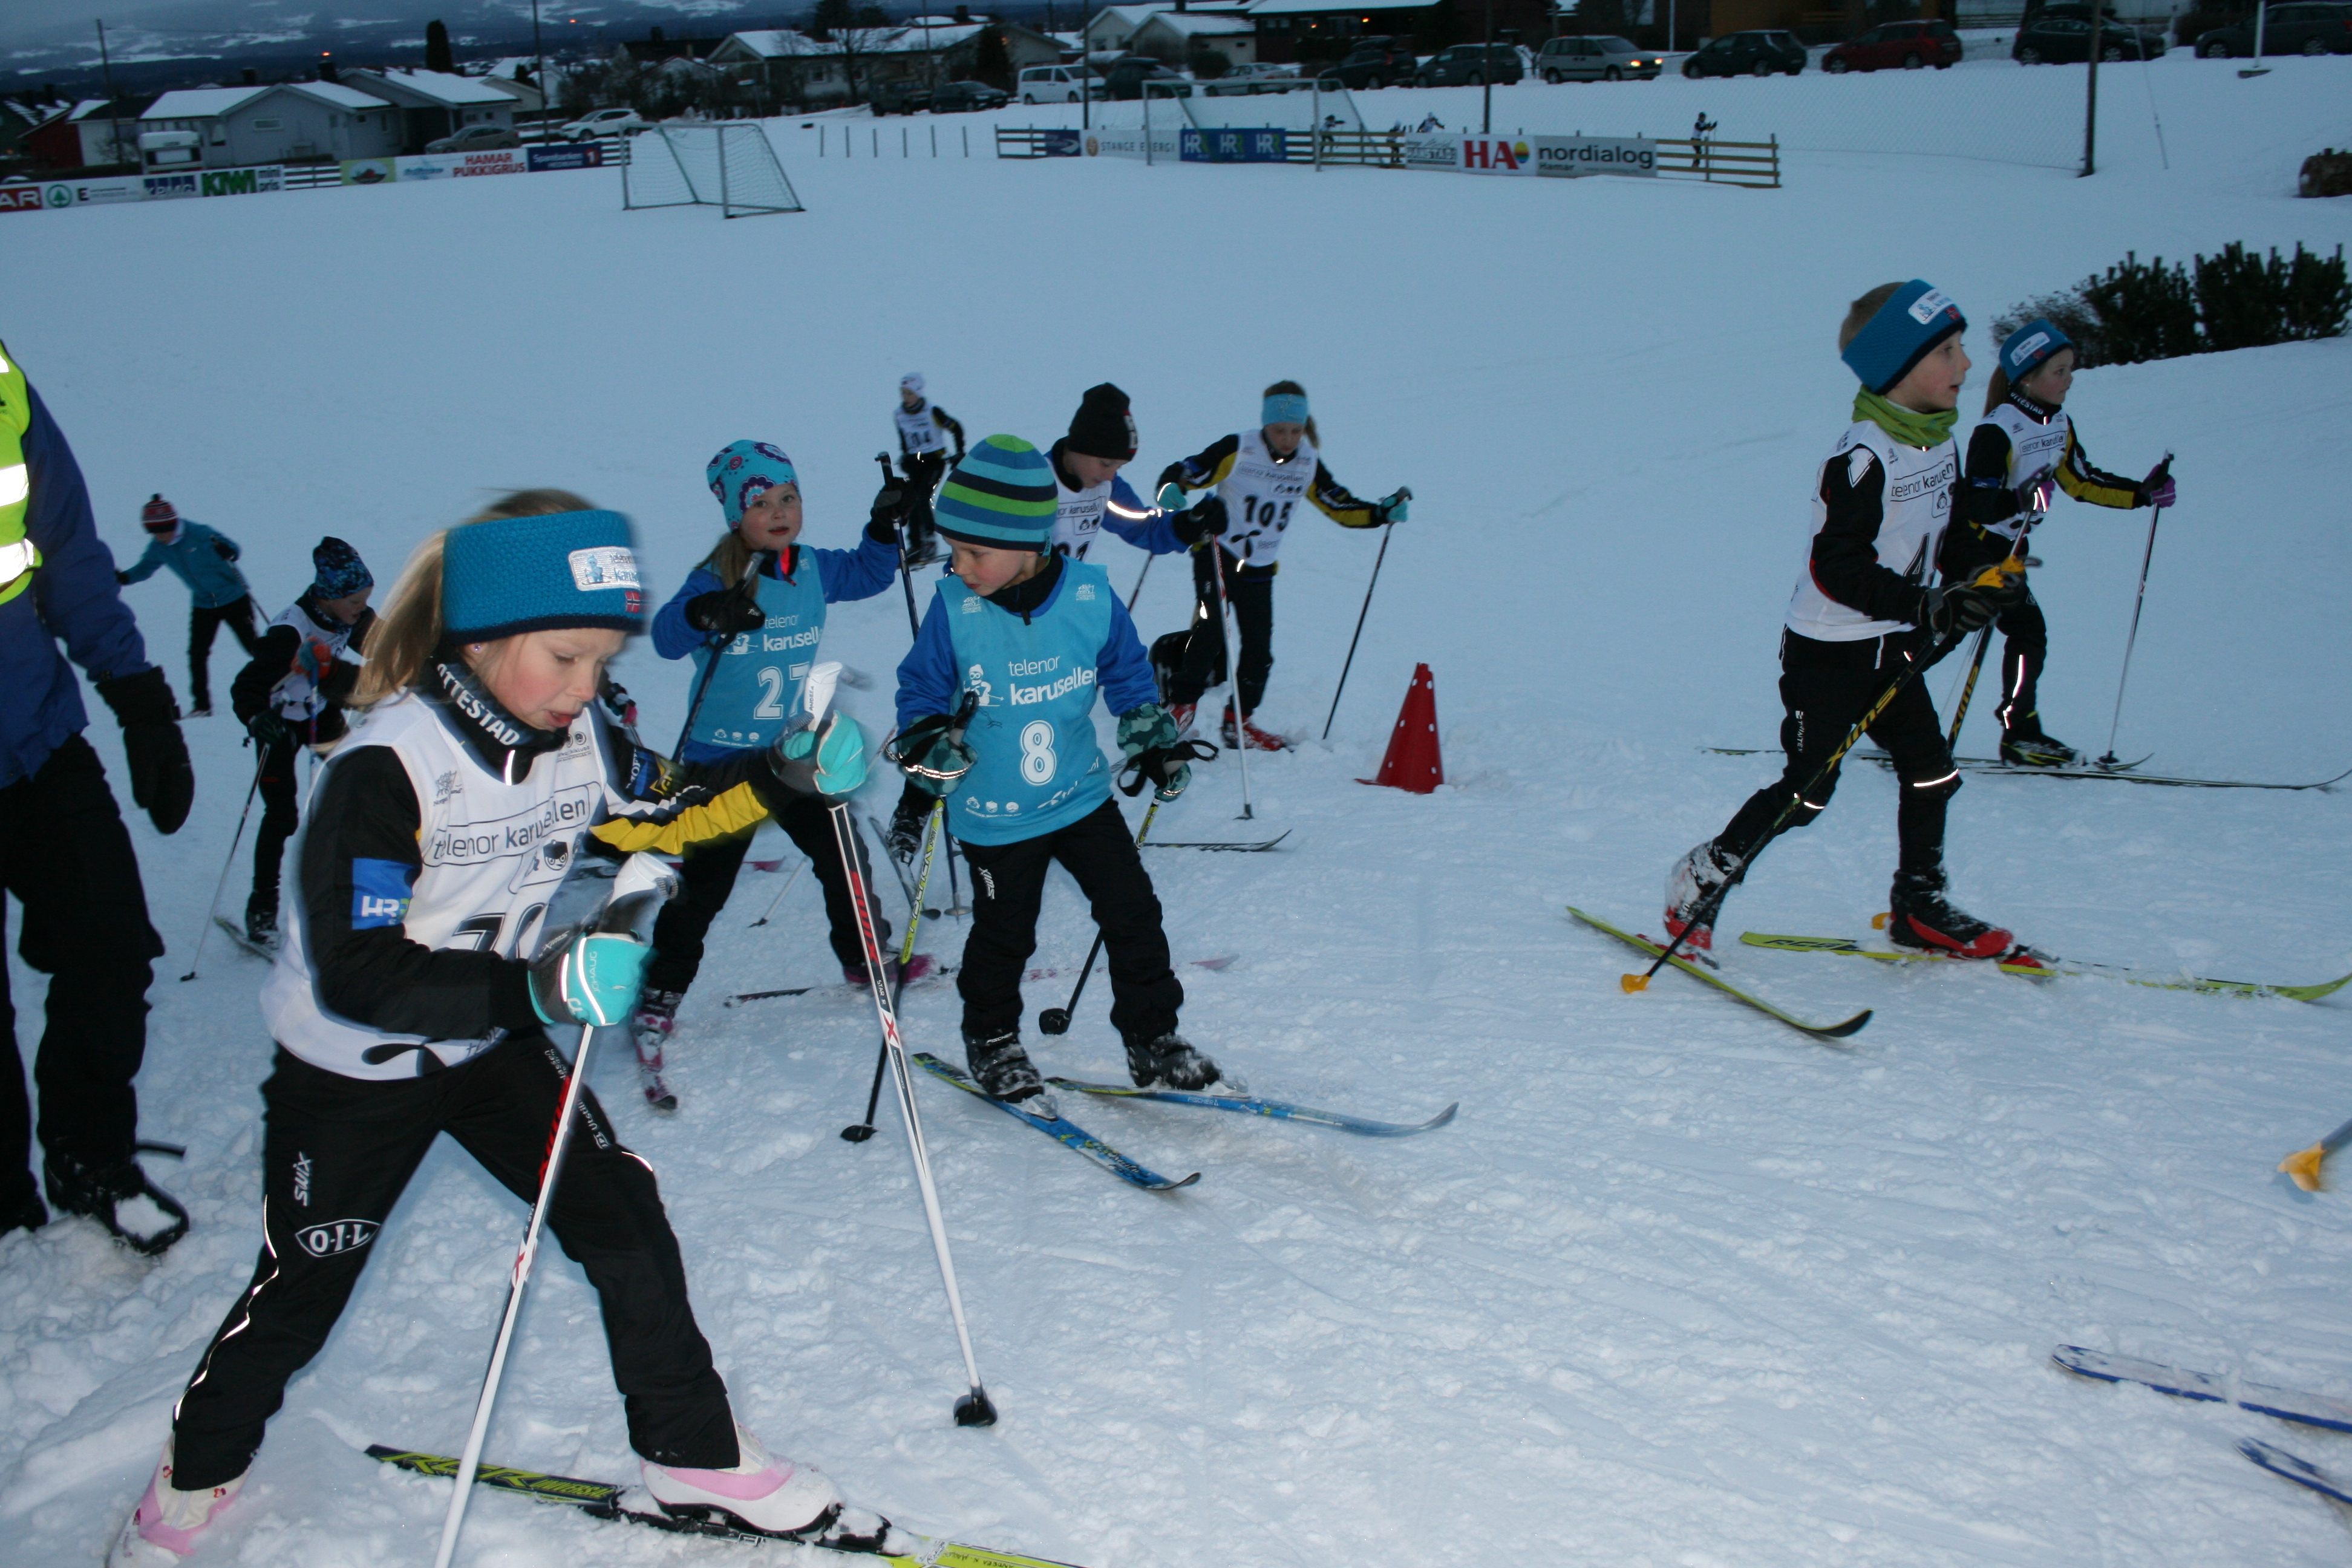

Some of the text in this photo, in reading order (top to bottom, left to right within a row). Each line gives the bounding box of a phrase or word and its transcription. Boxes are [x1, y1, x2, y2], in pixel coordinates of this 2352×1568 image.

[465, 152, 513, 165] HAMAR
[1100, 141, 1175, 153] STANGE EERGI
[1463, 140, 1520, 169] HA
[1538, 145, 1653, 169] nordialog
[201, 169, 257, 197] KIWI
[1244, 494, 1294, 532] 105
[1008, 655, 1060, 676] telenor
[754, 661, 810, 720] 27
[1020, 720, 1057, 786] 8
[877, 979, 886, 997] STAR
[1187, 1096, 1214, 1106] FISCHER
